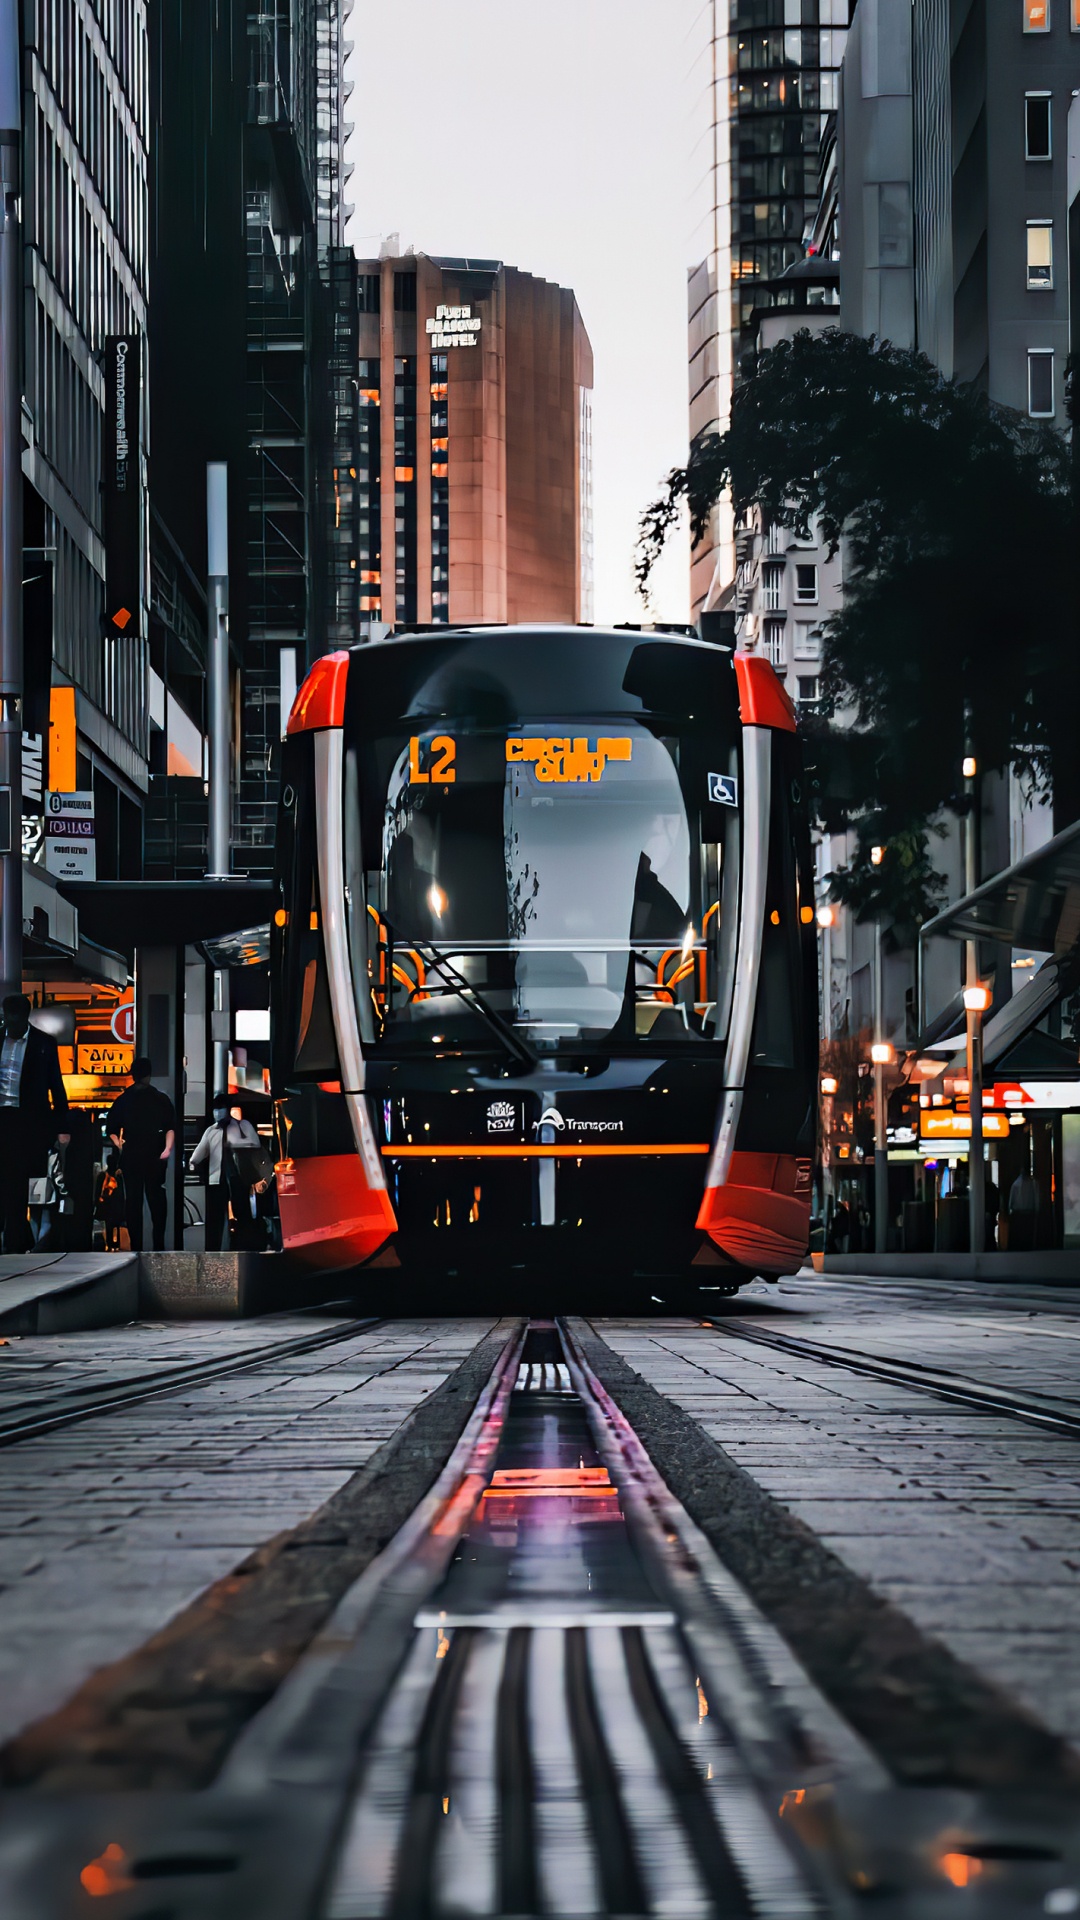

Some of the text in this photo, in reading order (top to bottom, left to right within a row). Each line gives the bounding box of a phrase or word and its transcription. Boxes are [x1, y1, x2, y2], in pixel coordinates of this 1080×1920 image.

[409, 736, 456, 783] L2
[487, 1118, 515, 1130] NSW
[566, 1118, 624, 1132] Transport
